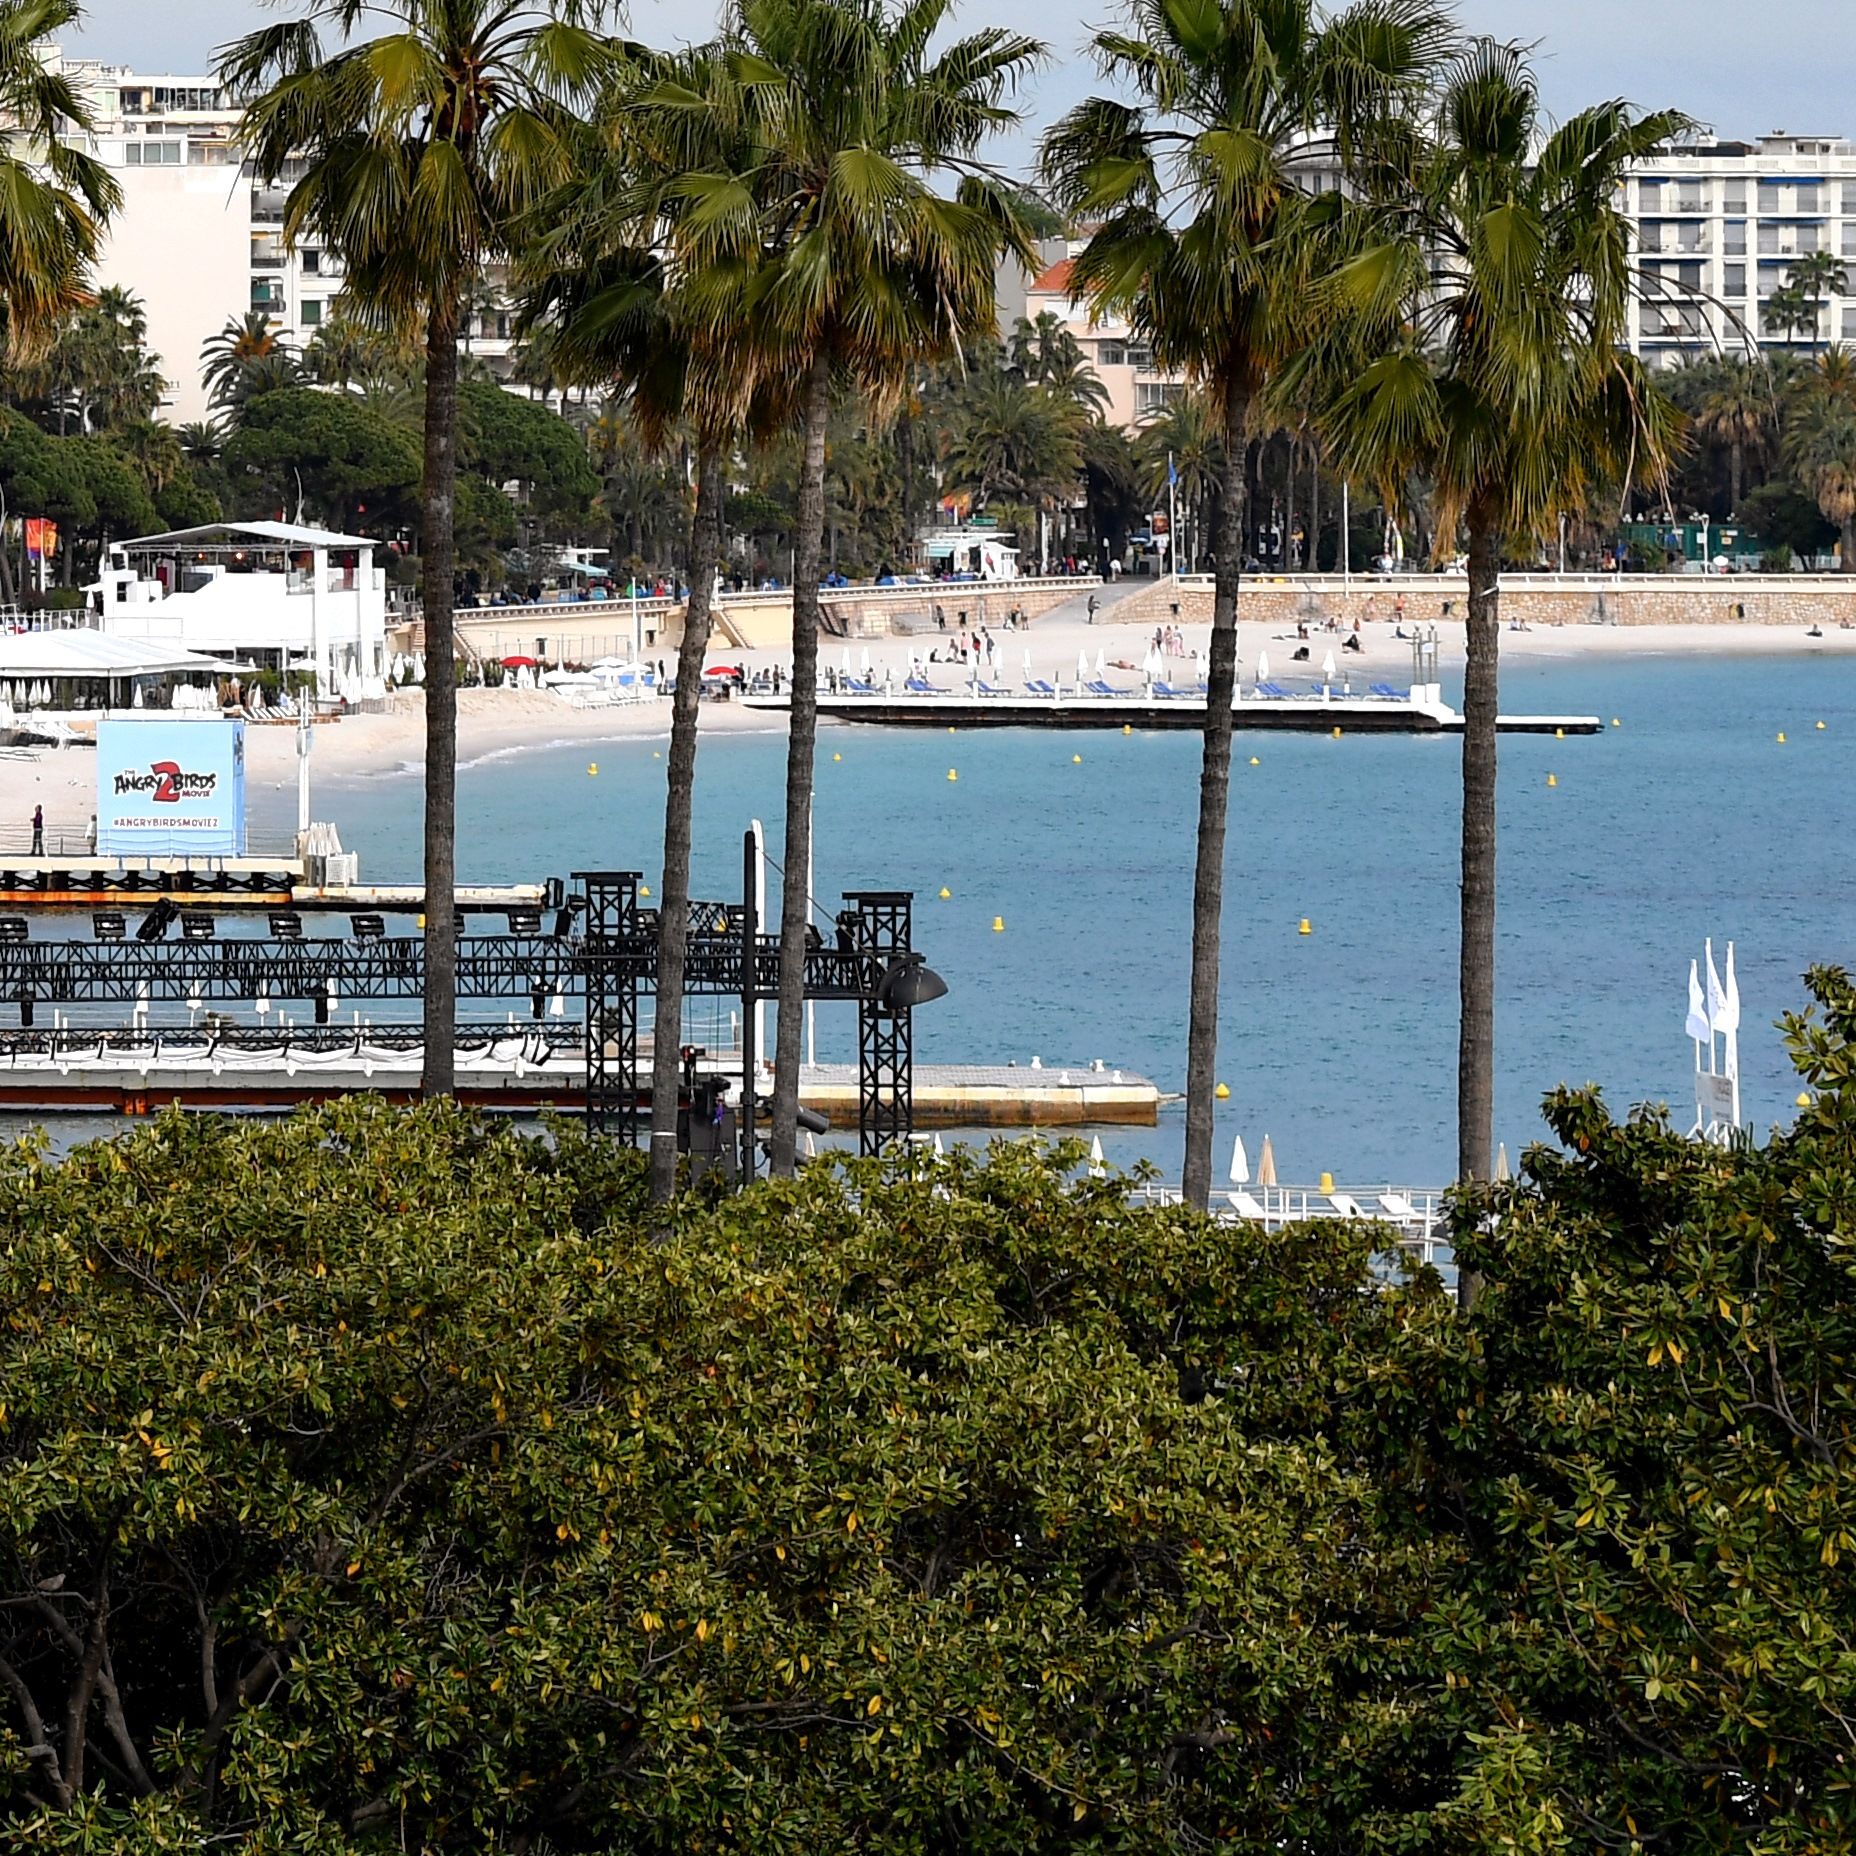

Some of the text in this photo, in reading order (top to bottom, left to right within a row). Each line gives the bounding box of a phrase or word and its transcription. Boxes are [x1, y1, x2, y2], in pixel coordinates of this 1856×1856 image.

[114, 761, 217, 802] ANGRY 2 BIRDS
